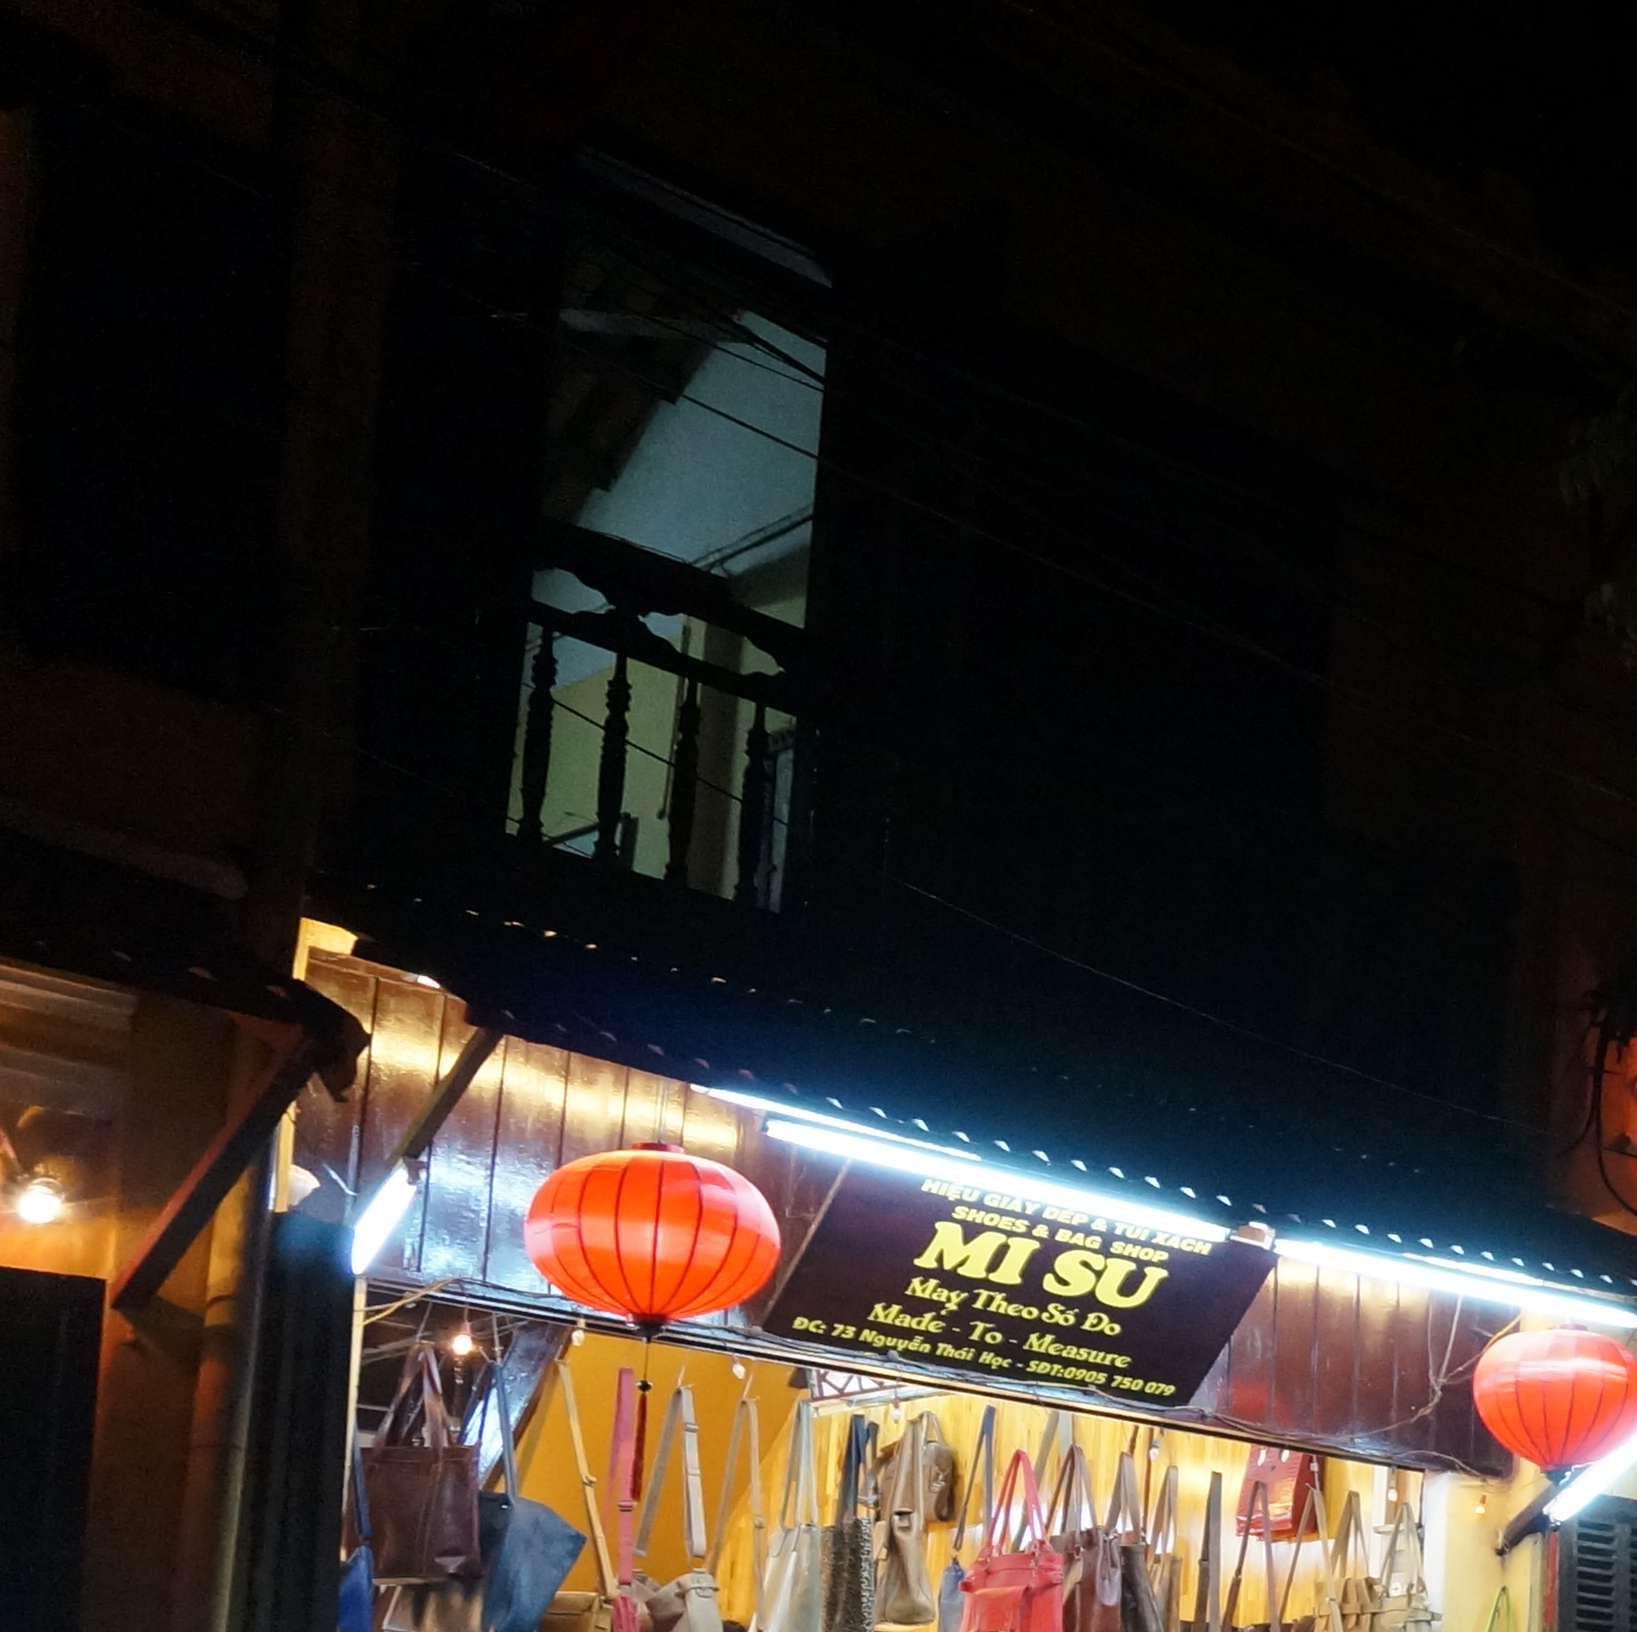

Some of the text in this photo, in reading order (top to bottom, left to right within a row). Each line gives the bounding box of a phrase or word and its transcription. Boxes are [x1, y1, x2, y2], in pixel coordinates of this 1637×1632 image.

[951, 1205, 1170, 1263] SHOES & BAG SHOP
[1090, 1217, 1107, 1232] &
[913, 1221, 1168, 1308] MI SU
[904, 1276, 968, 1315] May
[972, 1289, 1039, 1320] Theo
[831, 1323, 857, 1339] 73
[859, 1328, 931, 1354] Nguyễn
[935, 1342, 975, 1361] Thái
[979, 1351, 1012, 1370] Học
[1111, 1375, 1145, 1391] 750
[1145, 1381, 1176, 1396] 079
[867, 1302, 946, 1333] Made
[968, 1320, 1003, 1344] To
[1022, 1332, 1133, 1368] Measure
